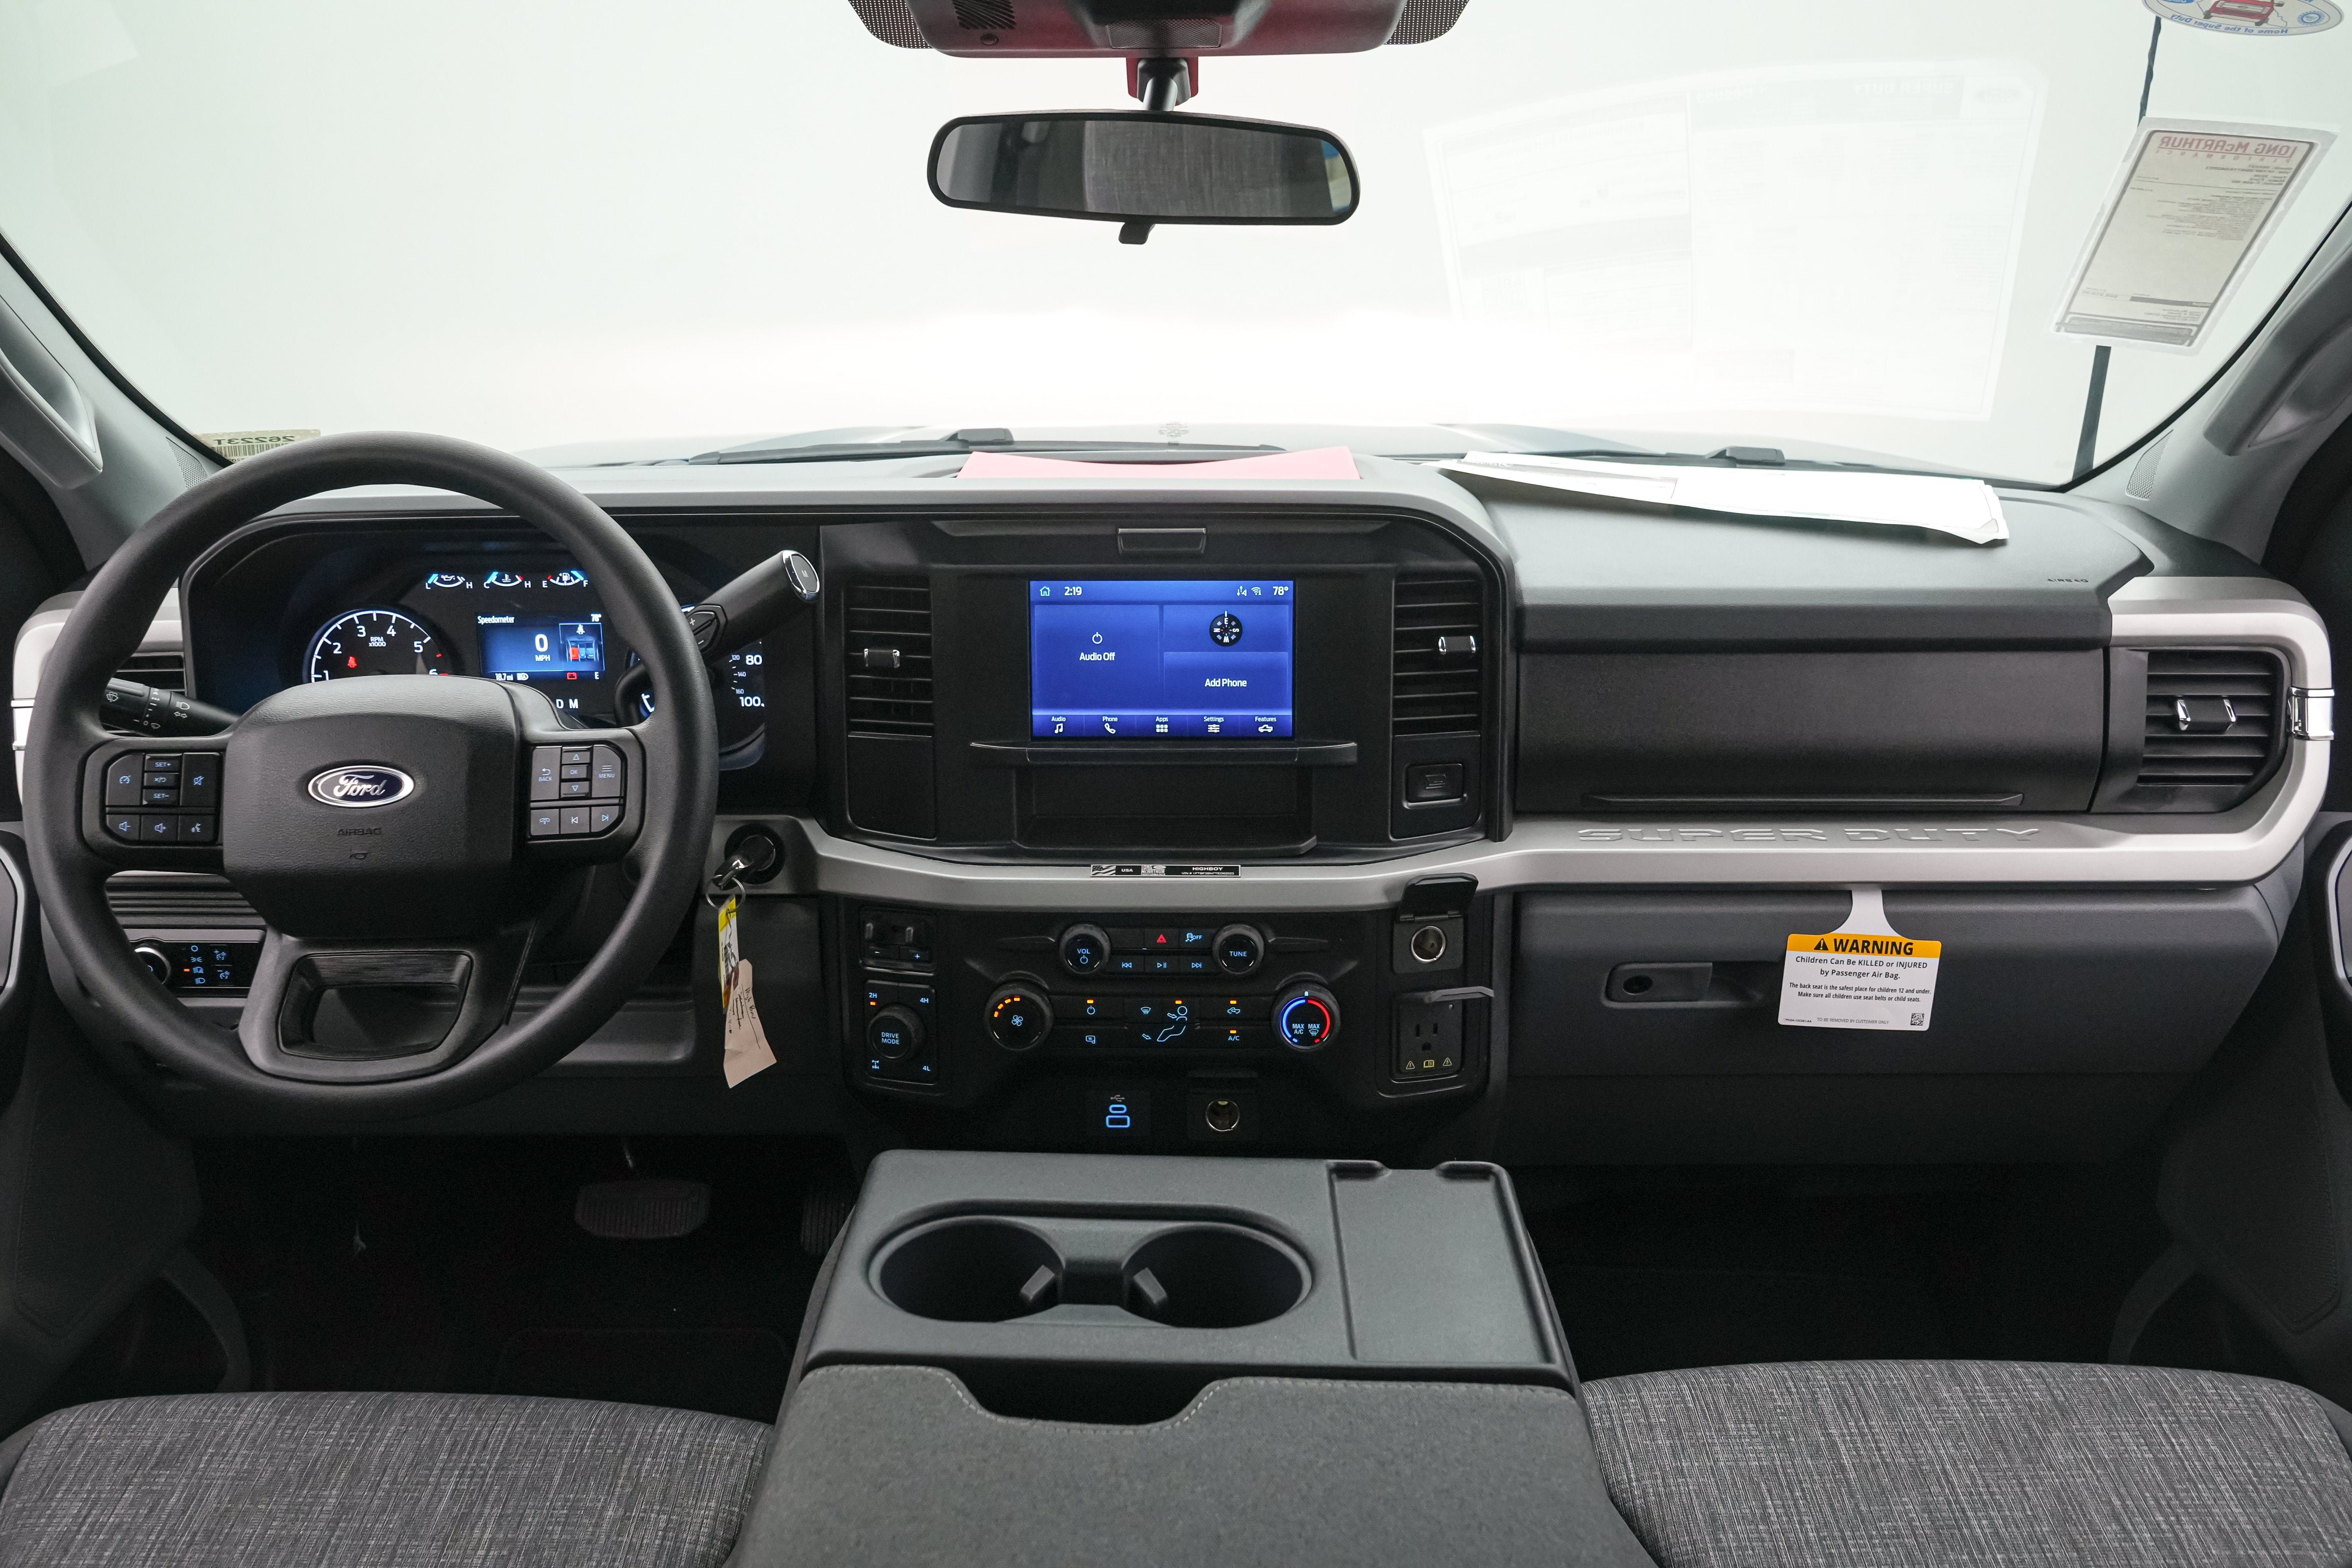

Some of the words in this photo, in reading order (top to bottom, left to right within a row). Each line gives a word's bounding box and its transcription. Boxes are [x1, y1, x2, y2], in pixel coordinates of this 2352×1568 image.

[1065, 587, 1082, 595] 2:19
[1273, 586, 1288, 595] 78°
[477, 616, 514, 624] Speedometer
[357, 626, 366, 637] 3
[387, 626, 396, 636] 4
[414, 641, 423, 653] 5
[535, 634, 548, 652] 0
[333, 643, 342, 654] 2
[746, 655, 762, 665] 80
[1080, 653, 1102, 661] Audio
[1103, 653, 1115, 661] Off
[1205, 679, 1221, 687] Add
[1222, 679, 1247, 687] Phone
[556, 699, 564, 708] D
[569, 699, 578, 708] M
[333, 775, 387, 797] Ford
[1577, 828, 1827, 842] SUPER
[1844, 828, 2039, 842] DUTY
[1834, 938, 1914, 956] WARNING
[1831, 969, 1869, 978] Passenger
